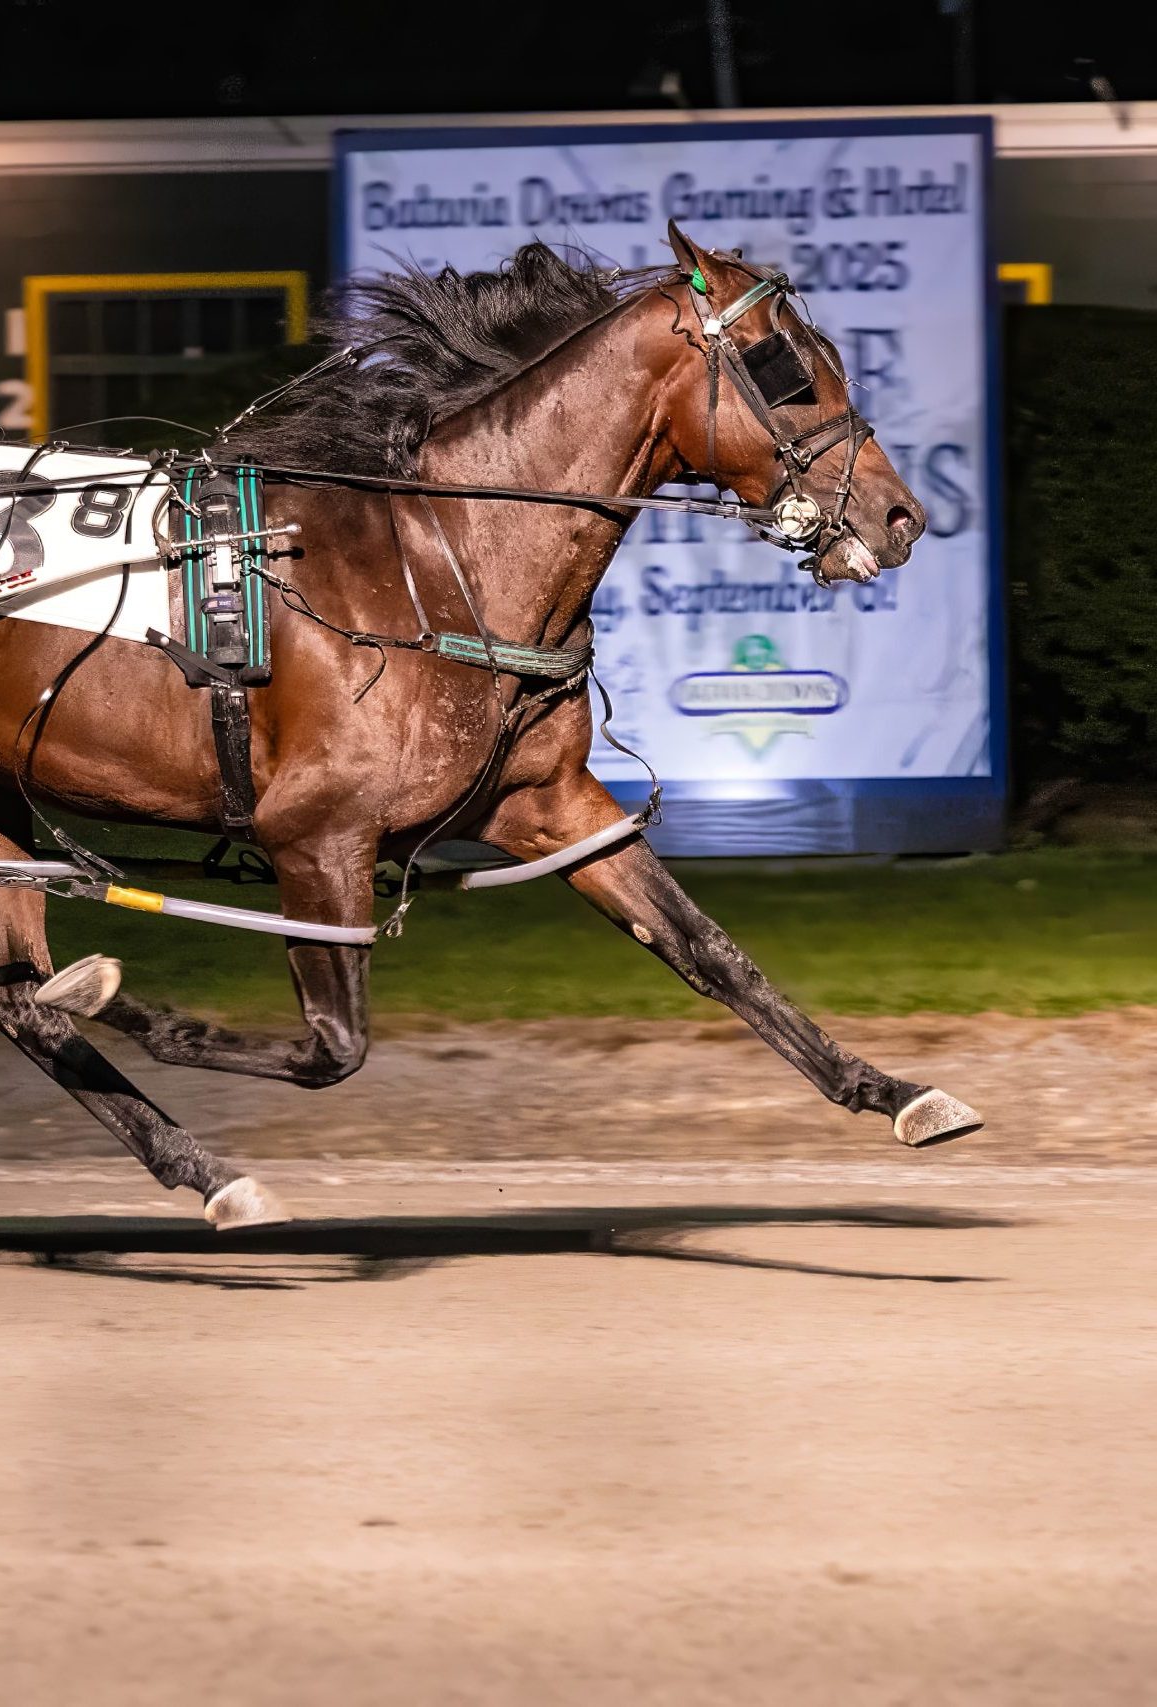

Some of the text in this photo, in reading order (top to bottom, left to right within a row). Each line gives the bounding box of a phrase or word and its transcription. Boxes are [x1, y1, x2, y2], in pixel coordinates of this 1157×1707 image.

[662, 172, 815, 235] Gaming
[823, 167, 857, 218] &
[864, 162, 967, 217] Hotel
[791, 241, 910, 292] 2025
[5, 308, 27, 355] 1
[71, 483, 133, 538] 8
